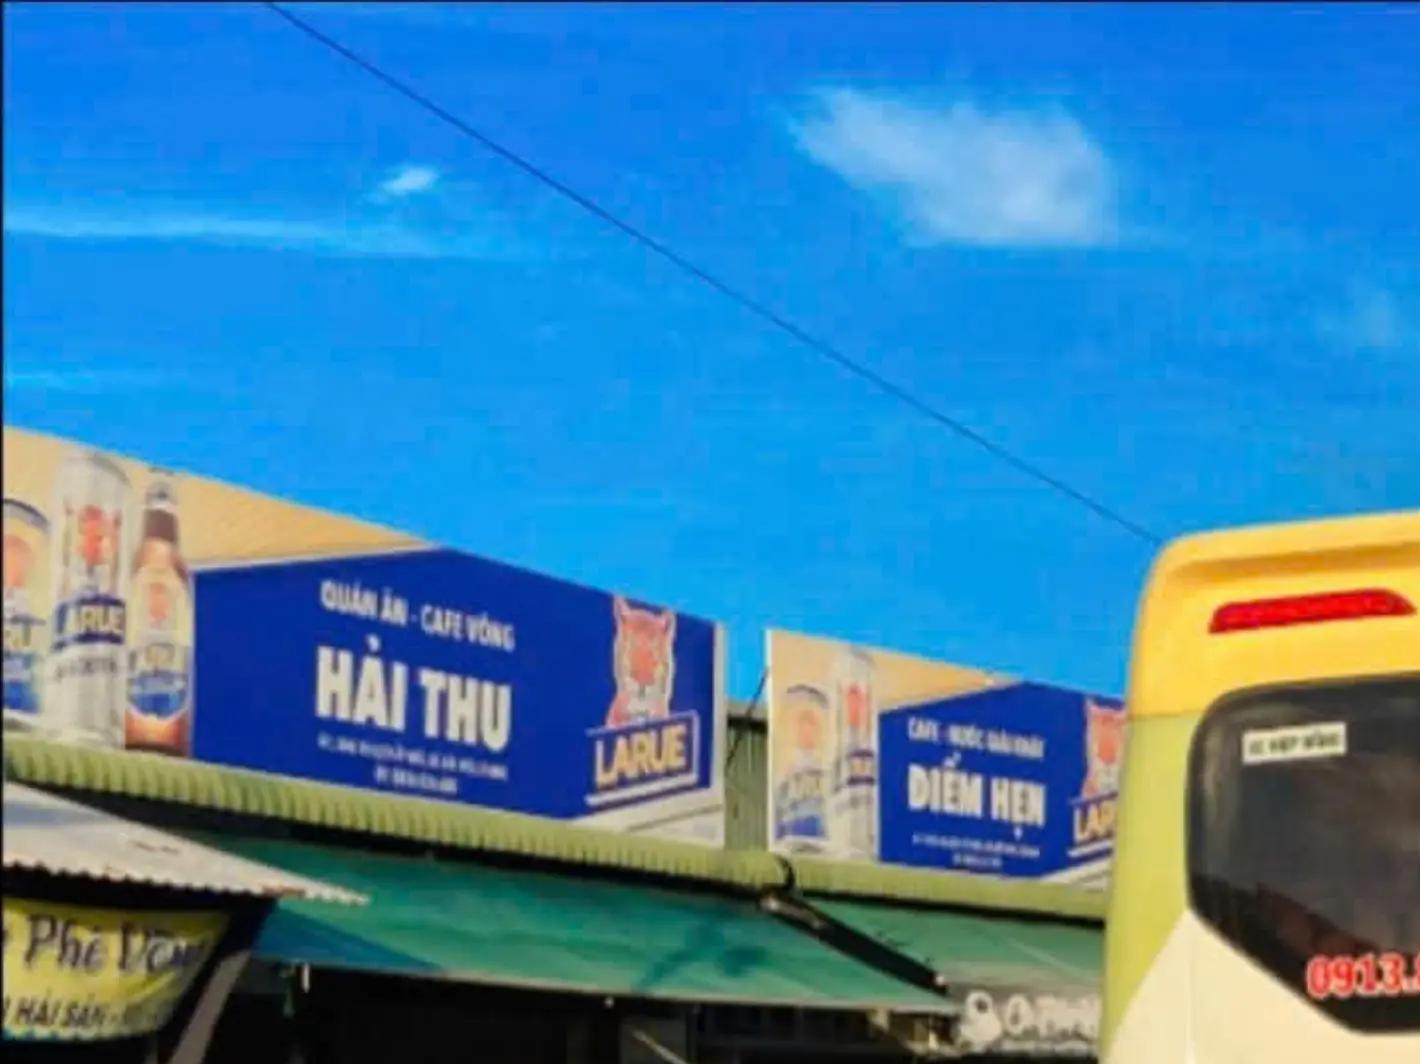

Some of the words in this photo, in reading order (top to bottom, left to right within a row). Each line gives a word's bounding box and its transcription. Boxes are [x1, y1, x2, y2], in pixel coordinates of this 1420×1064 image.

[320, 578, 378, 619] QUÁN
[421, 603, 463, 642] CAFE
[316, 633, 408, 733] HẢI
[418, 667, 512, 753] THU
[595, 724, 687, 790] LARUE
